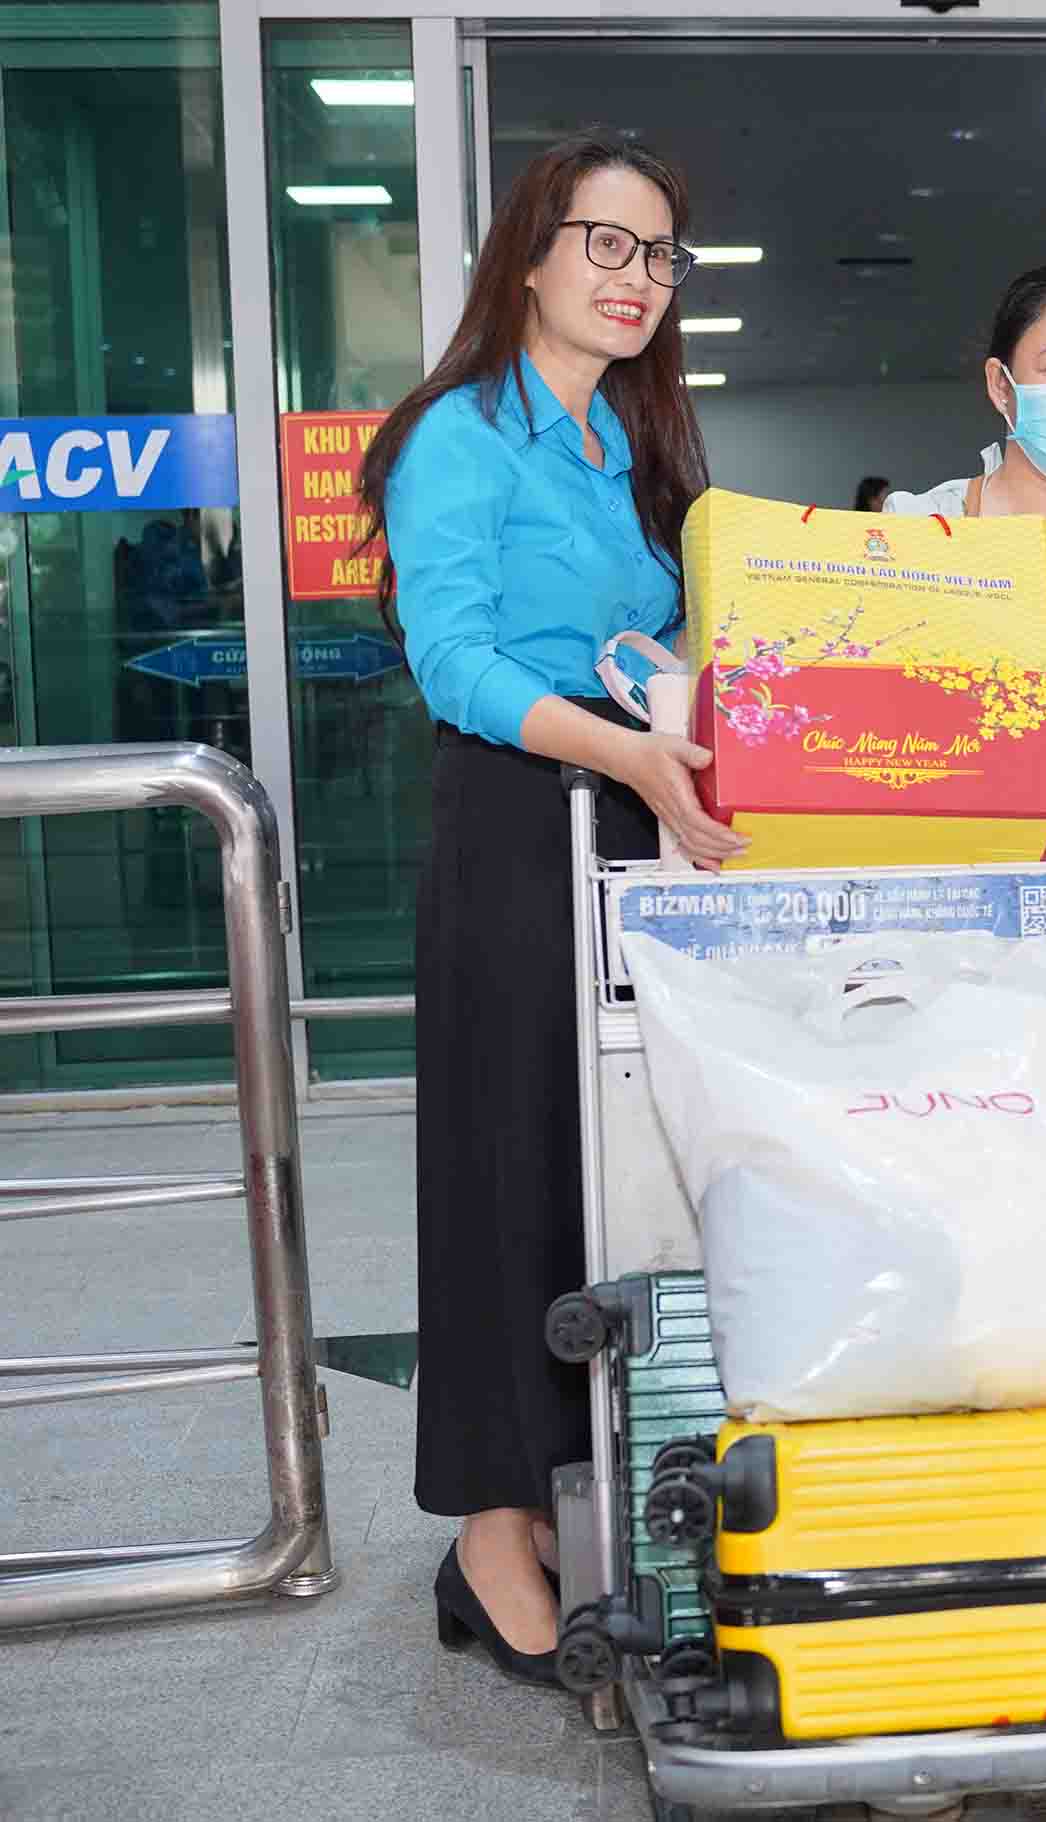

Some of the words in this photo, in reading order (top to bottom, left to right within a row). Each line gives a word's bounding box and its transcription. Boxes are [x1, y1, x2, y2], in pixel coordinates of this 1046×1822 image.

[303, 425, 351, 454] KHU
[0, 430, 171, 500] ACV
[303, 471, 353, 503] HẠN
[843, 756, 882, 768] HAPPY
[886, 758, 912, 768] NEW
[915, 759, 949, 769] YEAR
